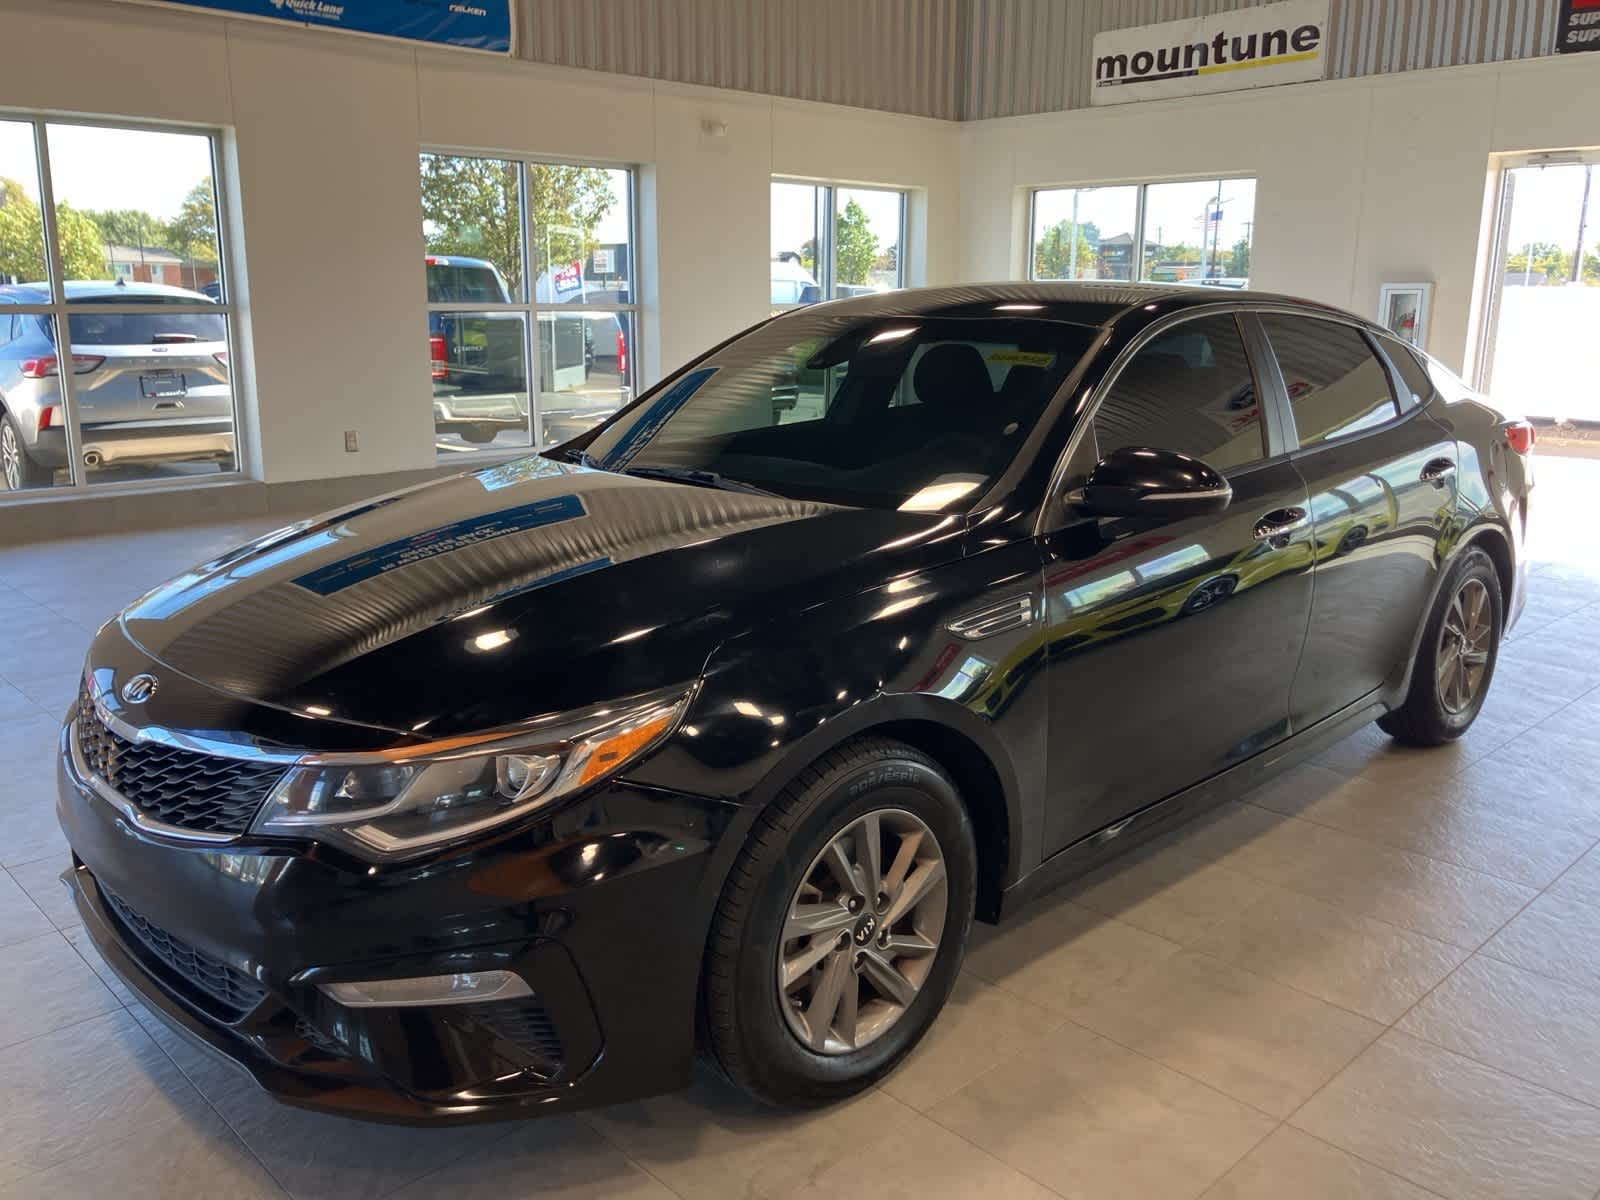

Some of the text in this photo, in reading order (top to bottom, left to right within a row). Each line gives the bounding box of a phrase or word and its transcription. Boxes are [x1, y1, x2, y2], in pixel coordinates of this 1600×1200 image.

[317, 2, 344, 15] Lane
[1096, 23, 1321, 81] mountune
[856, 918, 875, 941] KIA
